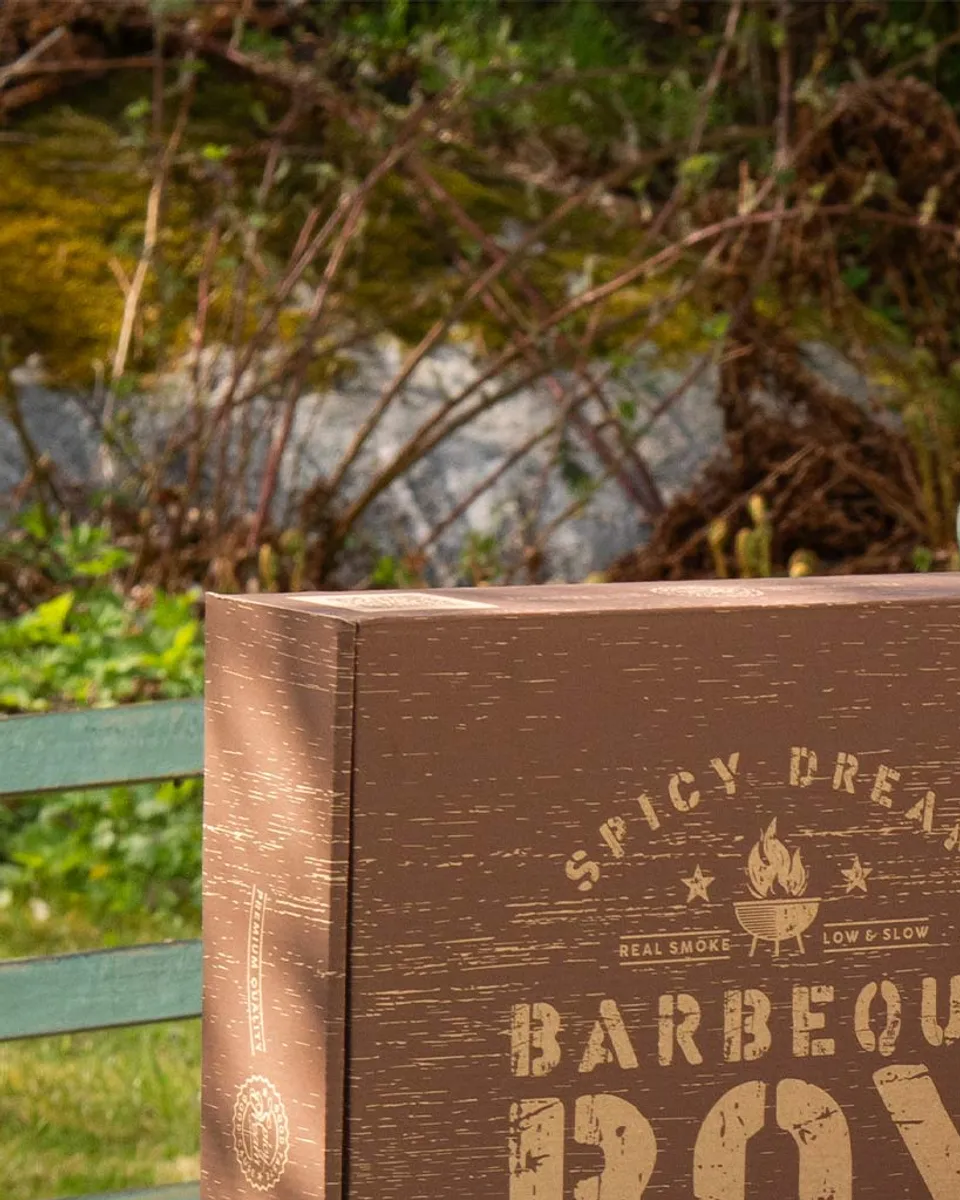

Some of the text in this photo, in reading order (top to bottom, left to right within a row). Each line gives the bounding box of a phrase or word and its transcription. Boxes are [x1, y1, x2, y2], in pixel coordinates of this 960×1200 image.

[565, 751, 740, 891] SPICY
[250, 888, 264, 1053] PREMIUM QUALITY
[619, 937, 731, 958] REAL SMOKE
[822, 923, 930, 945] LOW & SLOW
